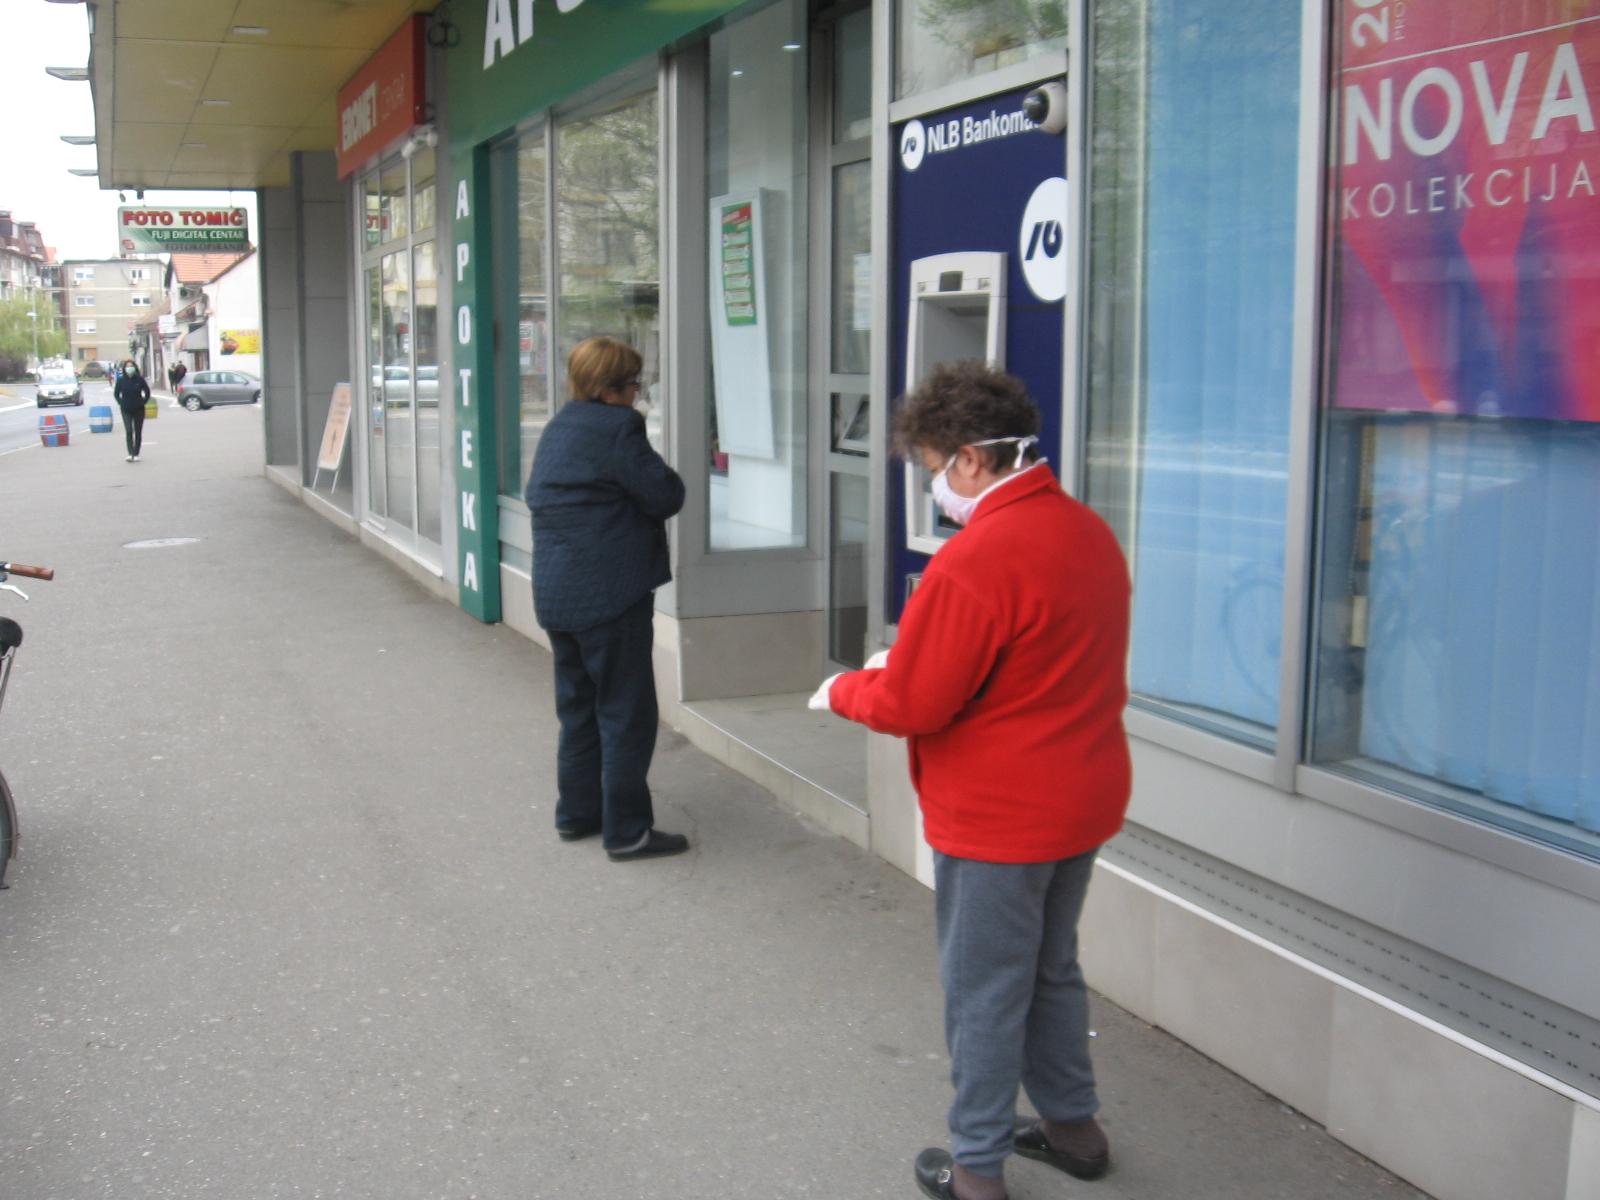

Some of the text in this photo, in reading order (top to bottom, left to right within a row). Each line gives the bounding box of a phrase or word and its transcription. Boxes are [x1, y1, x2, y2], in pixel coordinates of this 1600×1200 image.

[1344, 42, 1595, 165] NOVA
[927, 109, 1041, 154] NLB Bankoma
[1343, 160, 1595, 220] KOLEKCIJA
[122, 210, 174, 226] FOTO
[151, 230, 244, 240] FUJI DIGITAL CENTAR
[455, 179, 478, 592] APOTEKA
